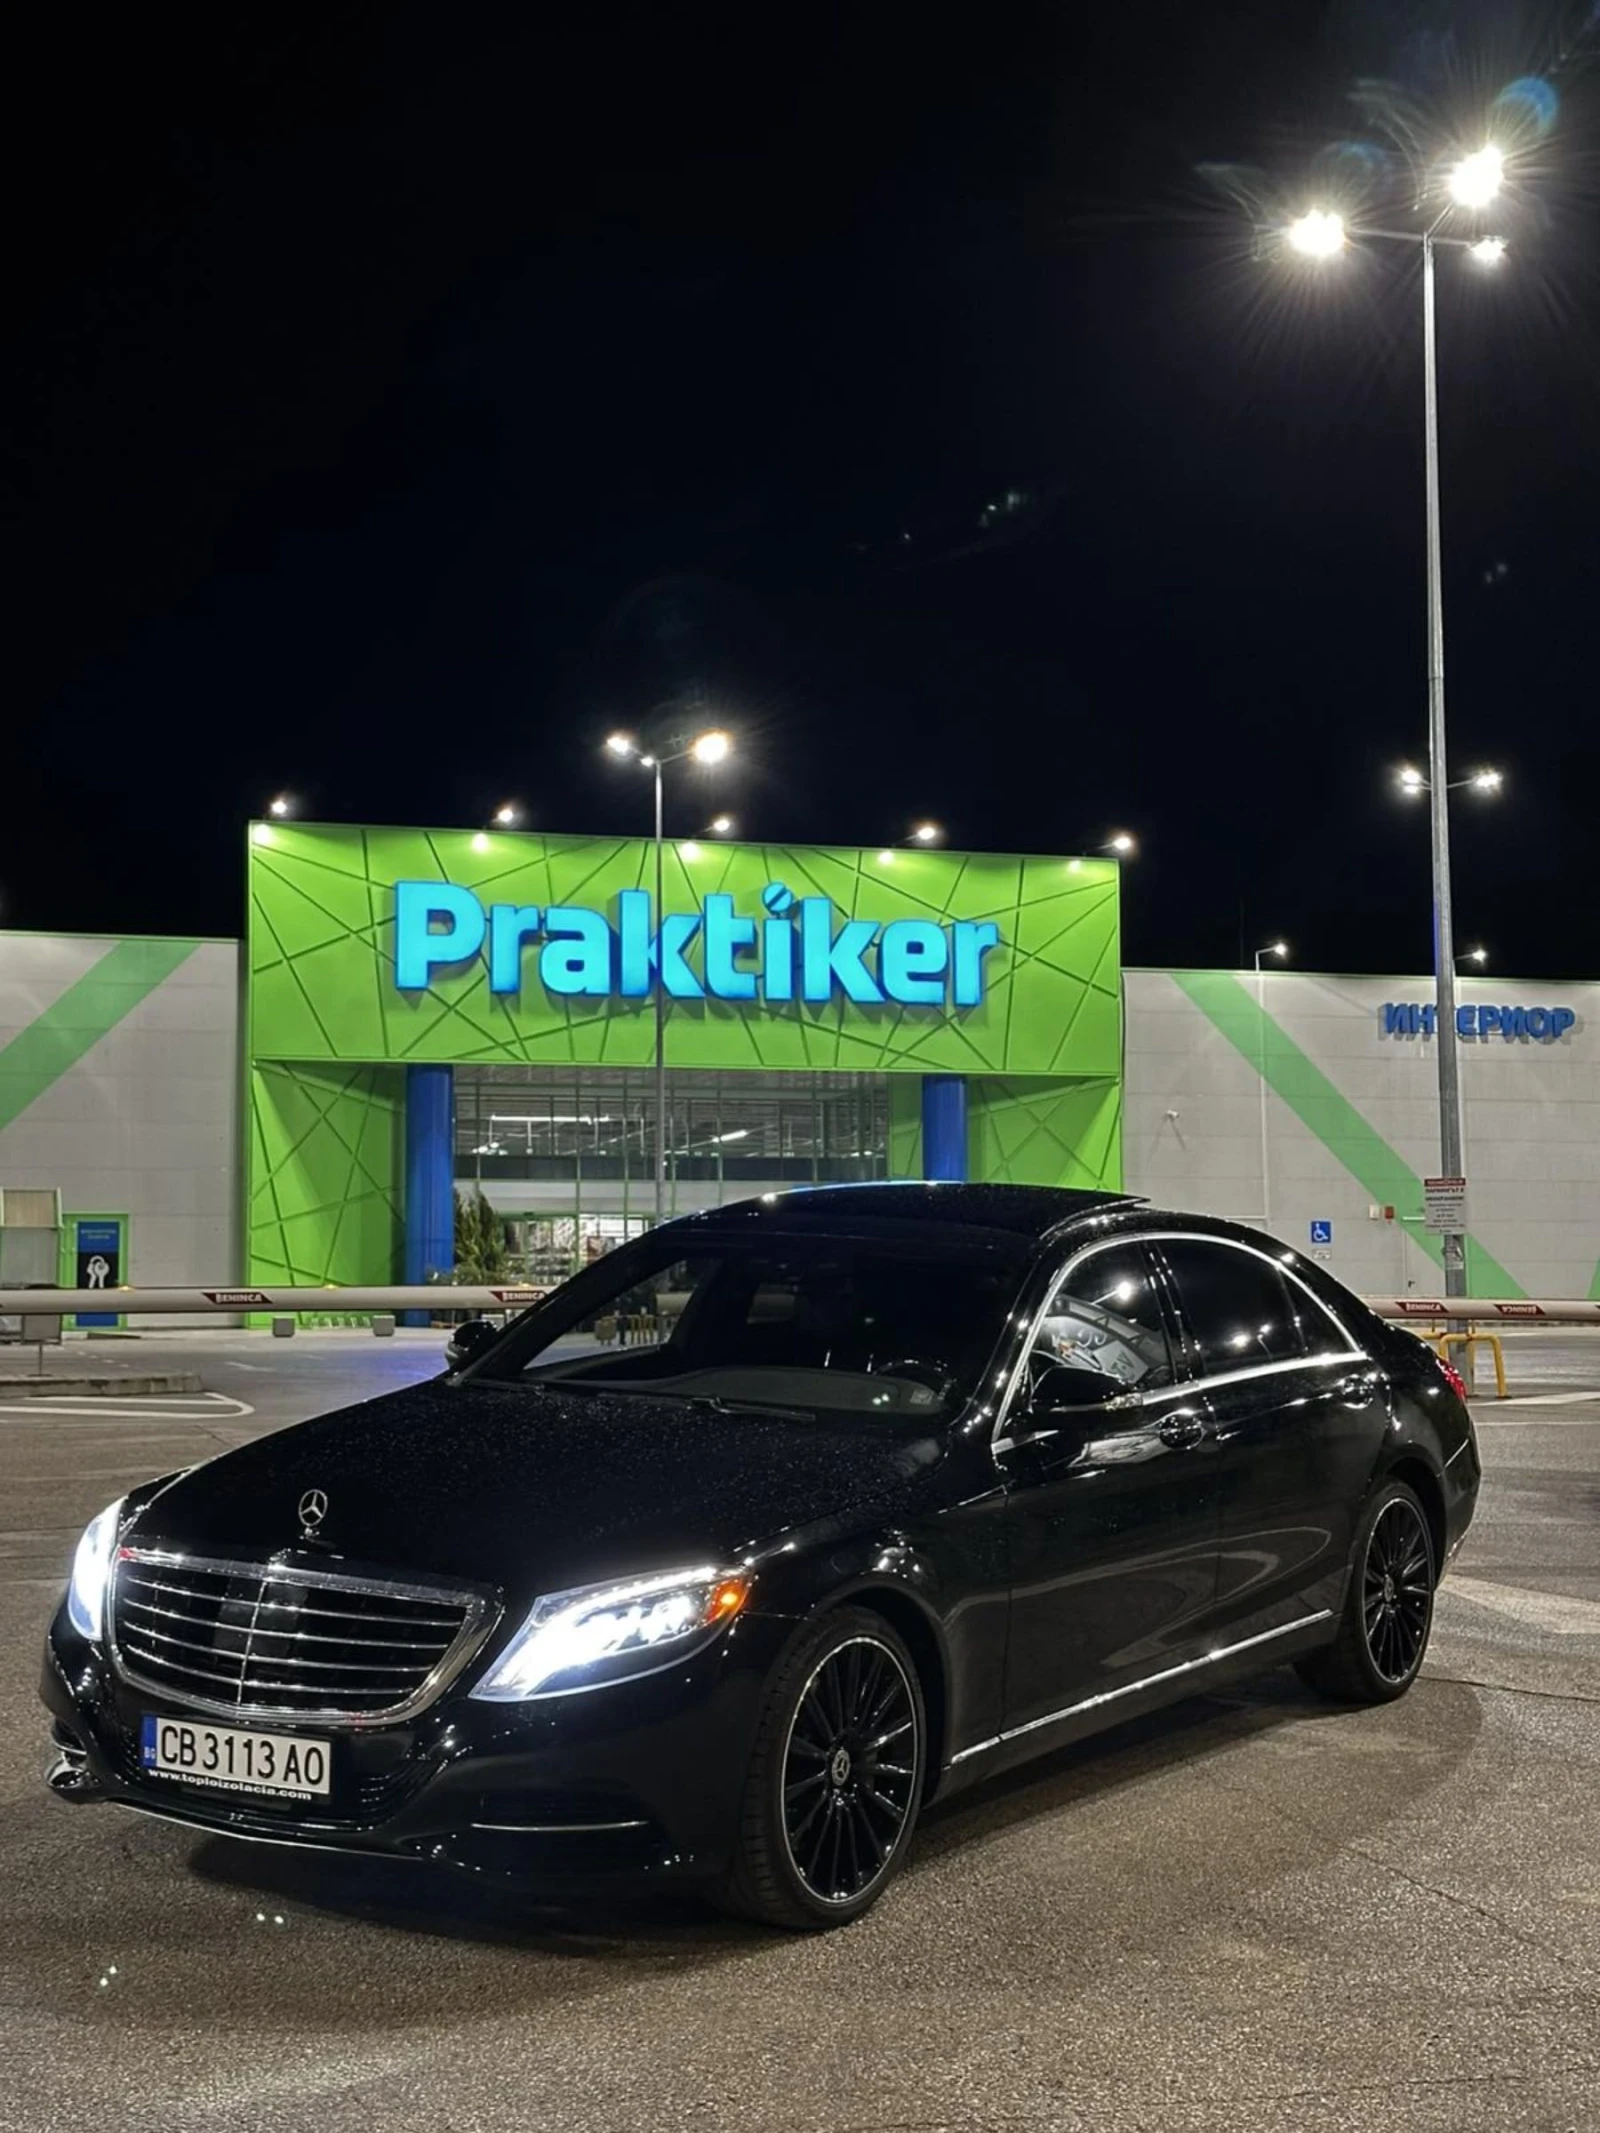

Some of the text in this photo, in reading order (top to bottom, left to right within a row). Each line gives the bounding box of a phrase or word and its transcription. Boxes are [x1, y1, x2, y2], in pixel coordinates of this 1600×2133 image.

[394, 881, 1000, 1008] Praktiker
[1384, 1002, 1576, 1038] ИНЕРИОР
[148, 1768, 312, 1801] www.toploizolacia.com
